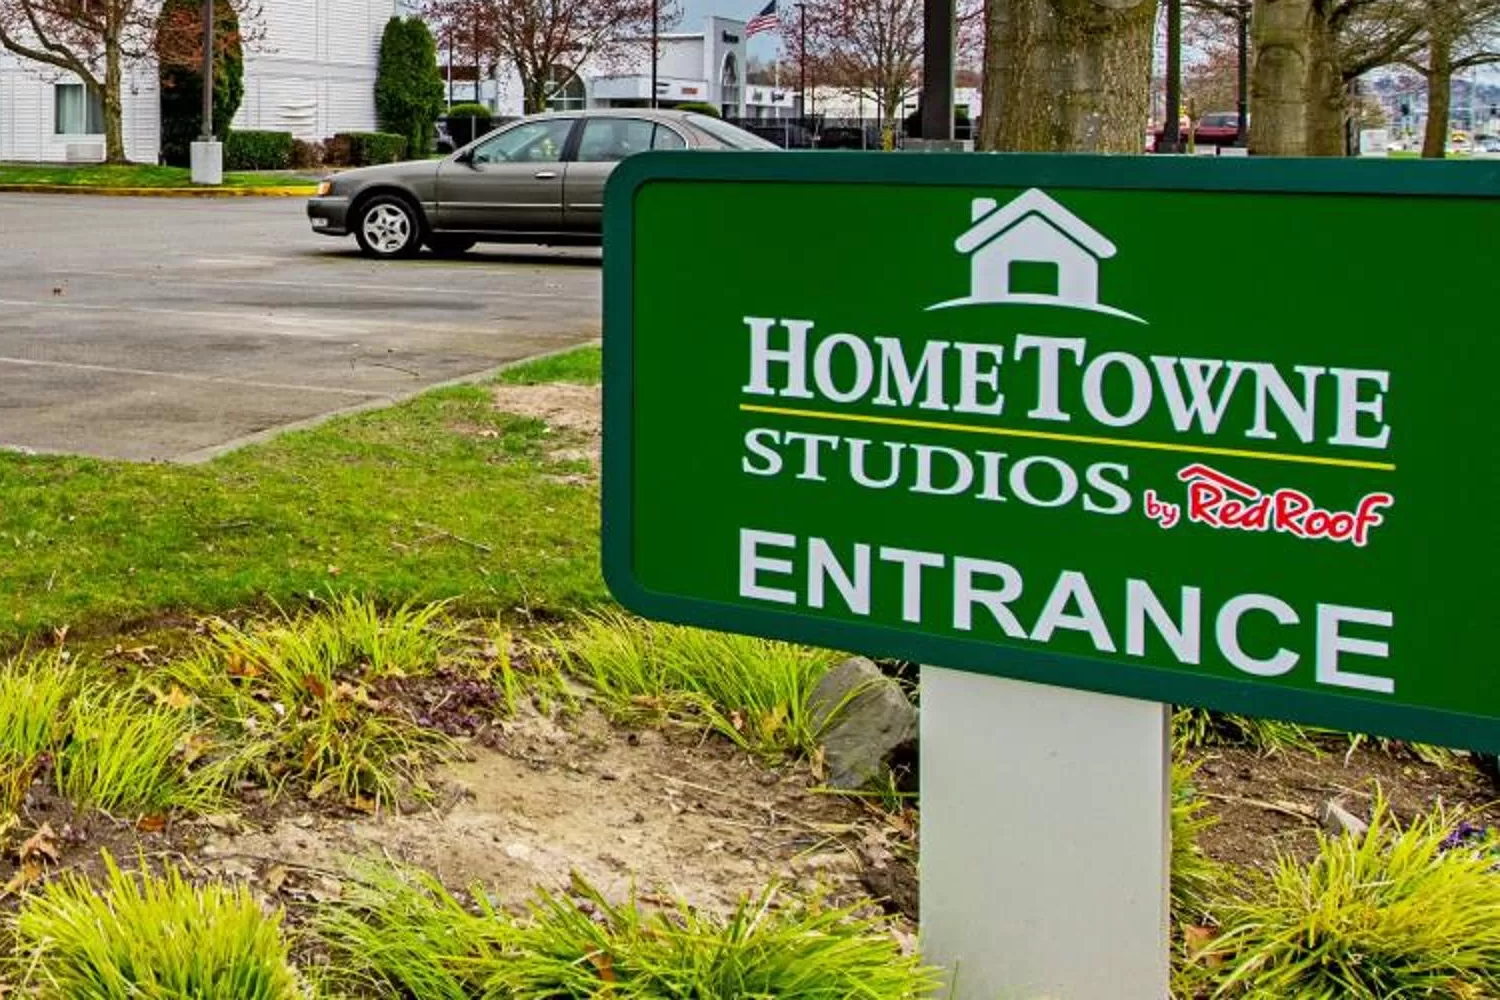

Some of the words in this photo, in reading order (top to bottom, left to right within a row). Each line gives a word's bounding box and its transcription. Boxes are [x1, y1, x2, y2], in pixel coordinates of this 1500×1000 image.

[742, 428, 1131, 514] STUDIOS
[1143, 489, 1181, 529] by
[739, 529, 1395, 693] ENTRANCE
